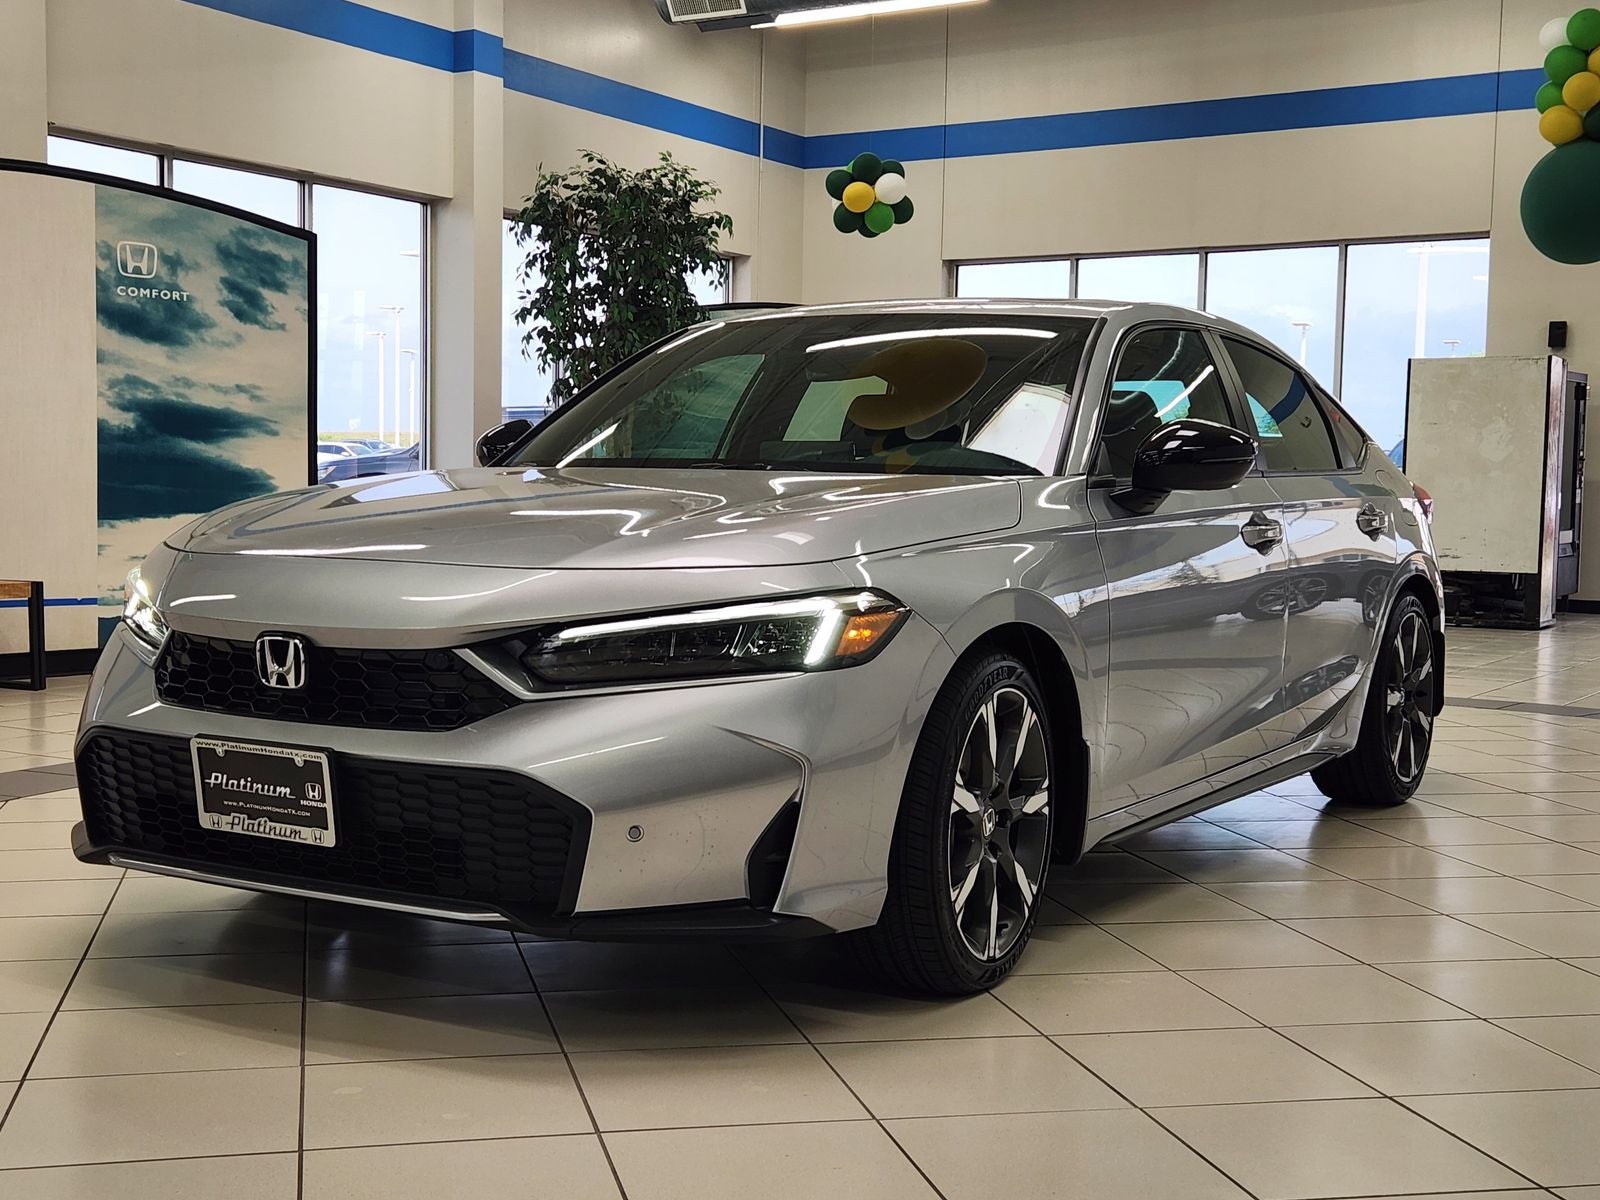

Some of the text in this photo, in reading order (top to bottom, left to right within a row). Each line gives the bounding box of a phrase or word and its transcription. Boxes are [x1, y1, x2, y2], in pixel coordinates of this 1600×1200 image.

[116, 286, 190, 302] COMFORT
[204, 772, 297, 799] Platinum
[300, 799, 328, 808] HONDA
[226, 815, 308, 841] Platinum
